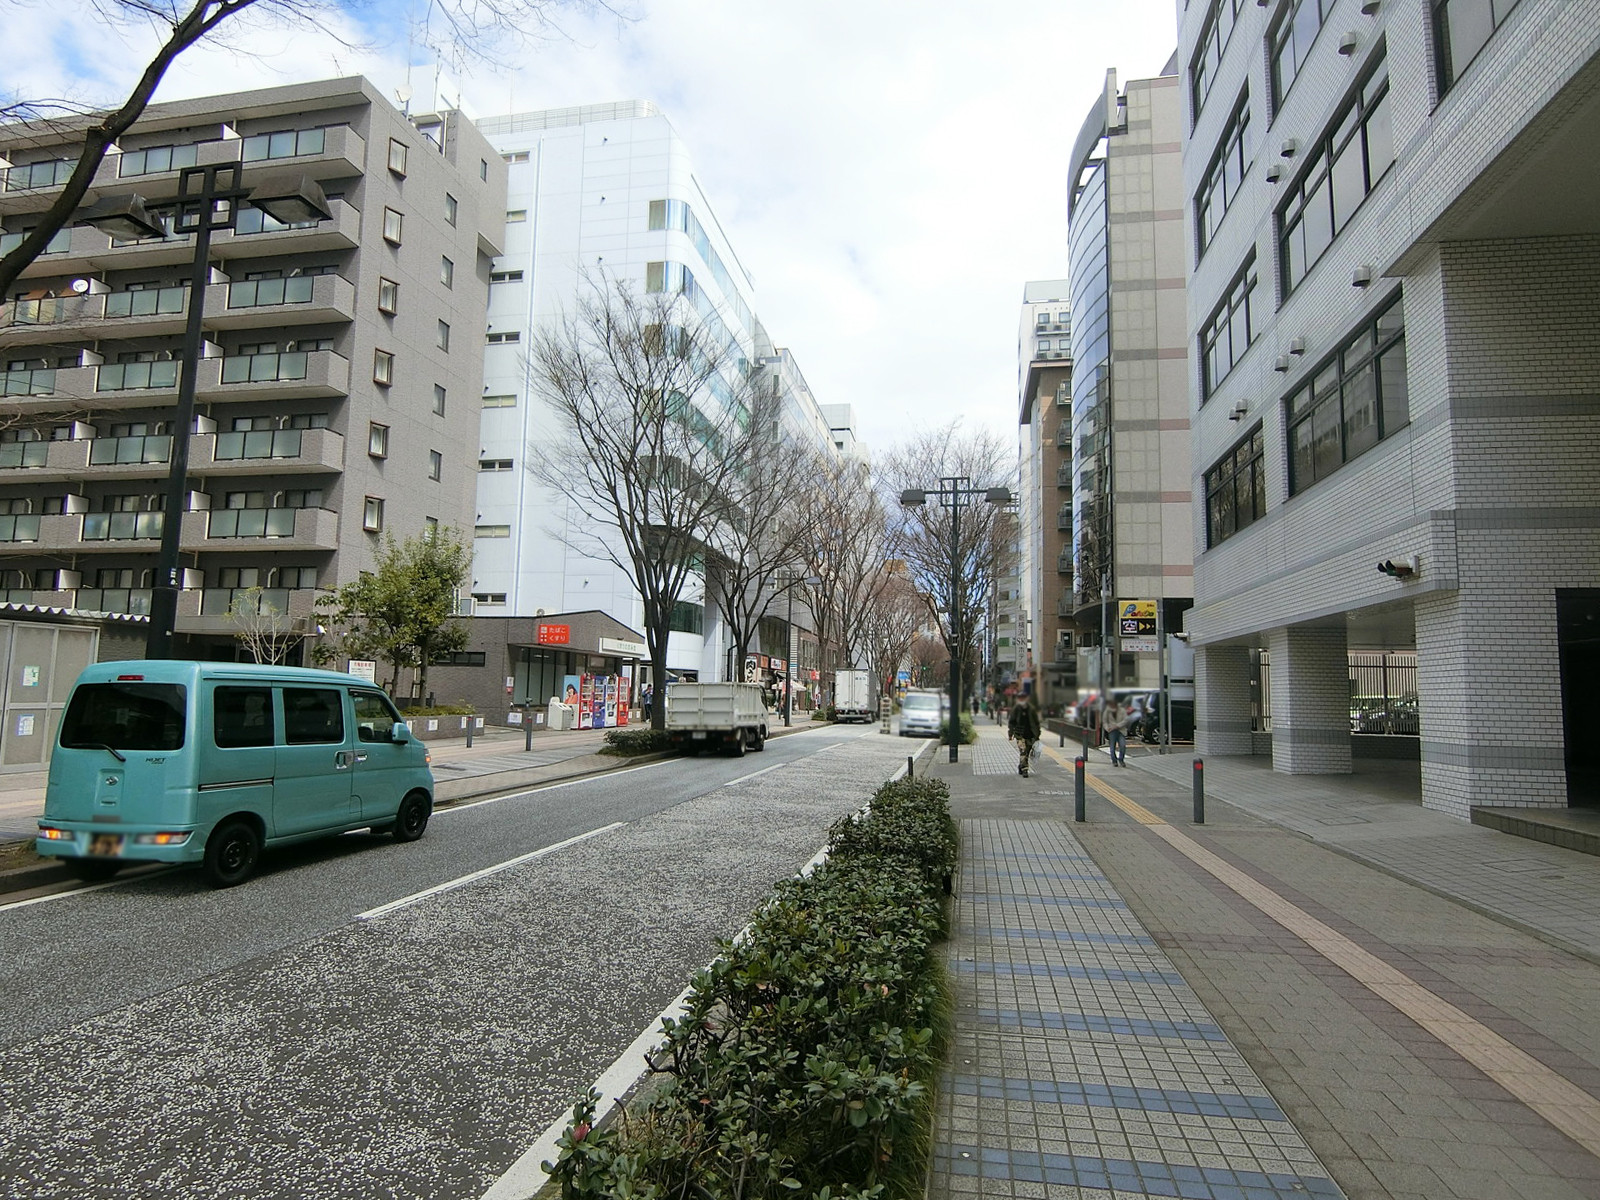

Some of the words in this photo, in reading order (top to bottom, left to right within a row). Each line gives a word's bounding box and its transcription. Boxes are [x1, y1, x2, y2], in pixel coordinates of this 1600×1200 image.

[549, 626, 566, 634] たばこ
[1122, 619, 1138, 634] 空
